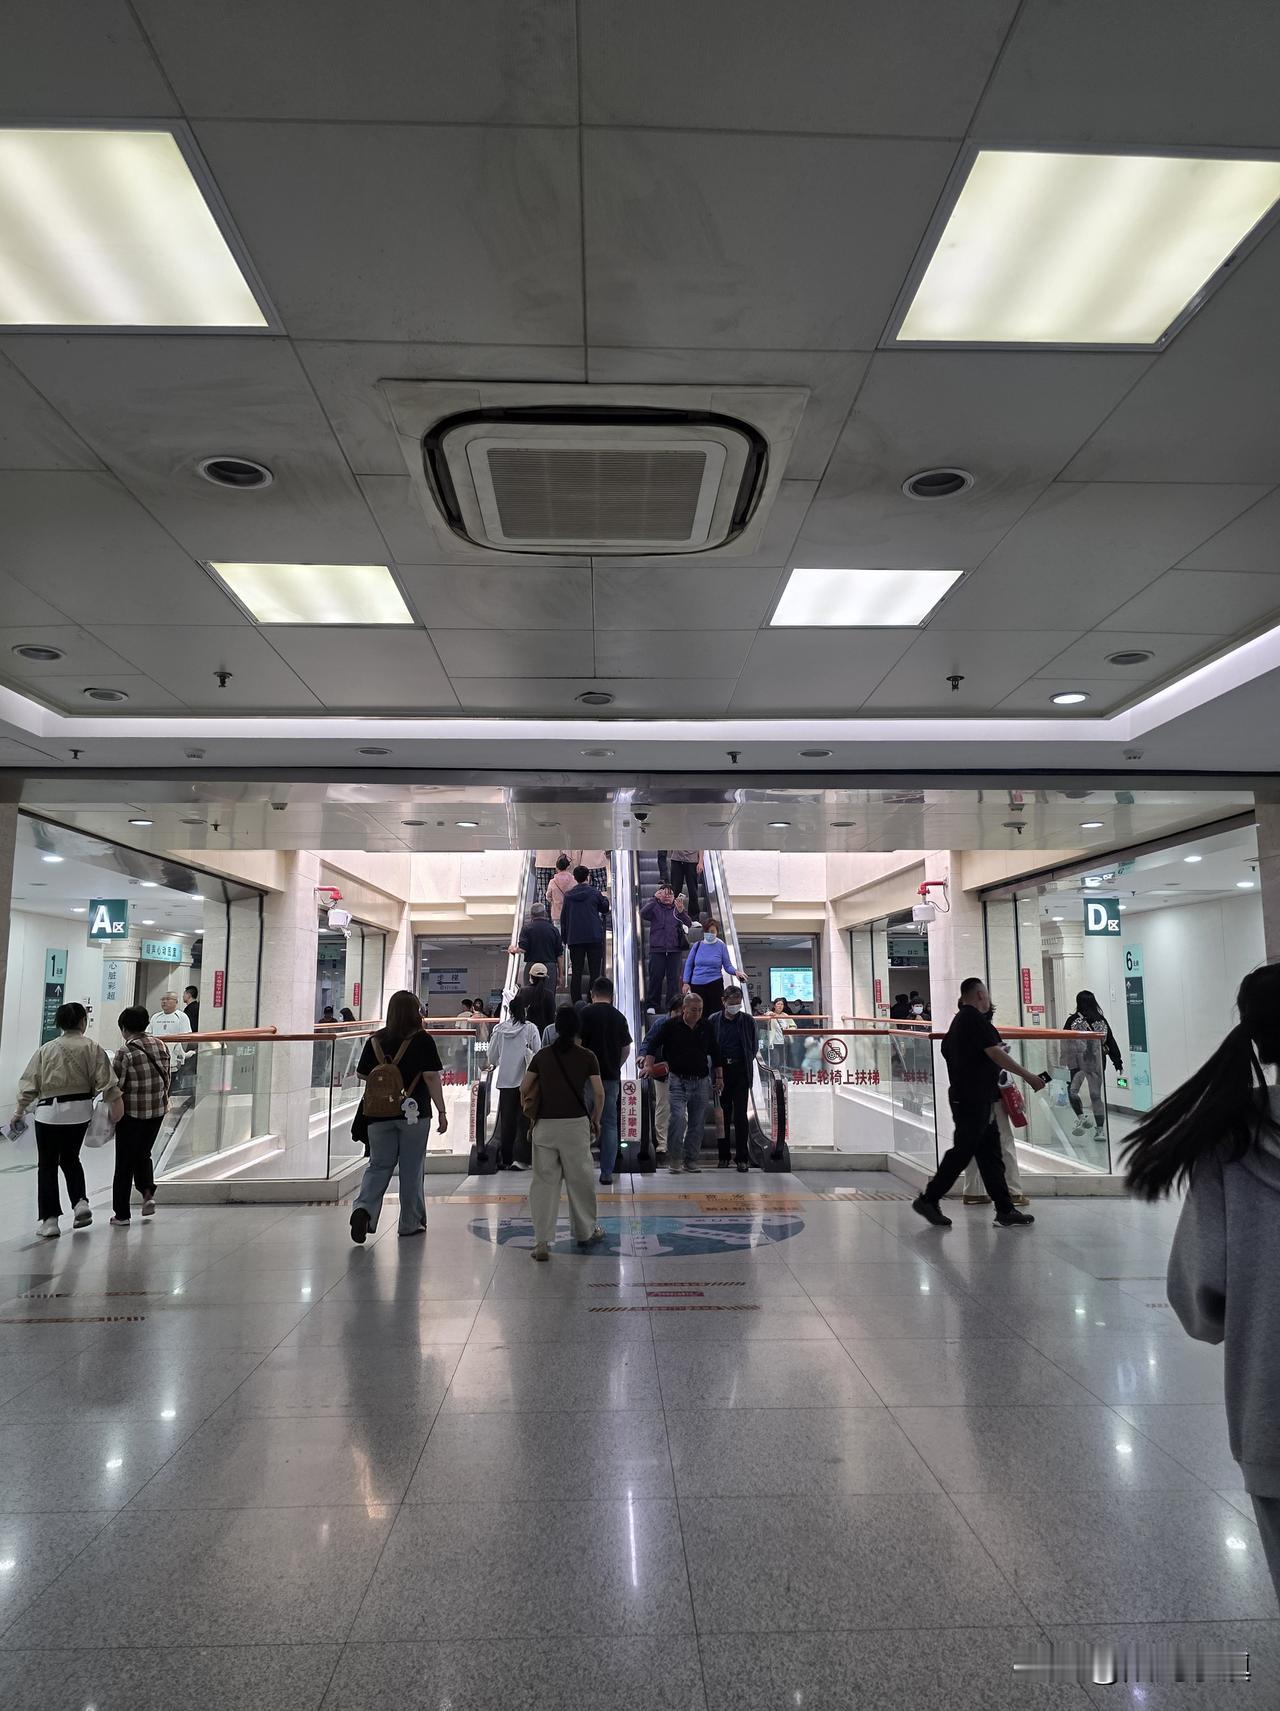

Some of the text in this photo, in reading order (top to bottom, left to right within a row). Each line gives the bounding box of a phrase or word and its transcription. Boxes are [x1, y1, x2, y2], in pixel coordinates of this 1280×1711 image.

[91, 904, 125, 933] A区
[1087, 903, 1120, 931] D区
[106, 962, 118, 1001] 心脏彩超
[792, 1069, 880, 1086] 禁止轮椅上扶梯
[627, 1095, 638, 1138] 禁止攀爬
